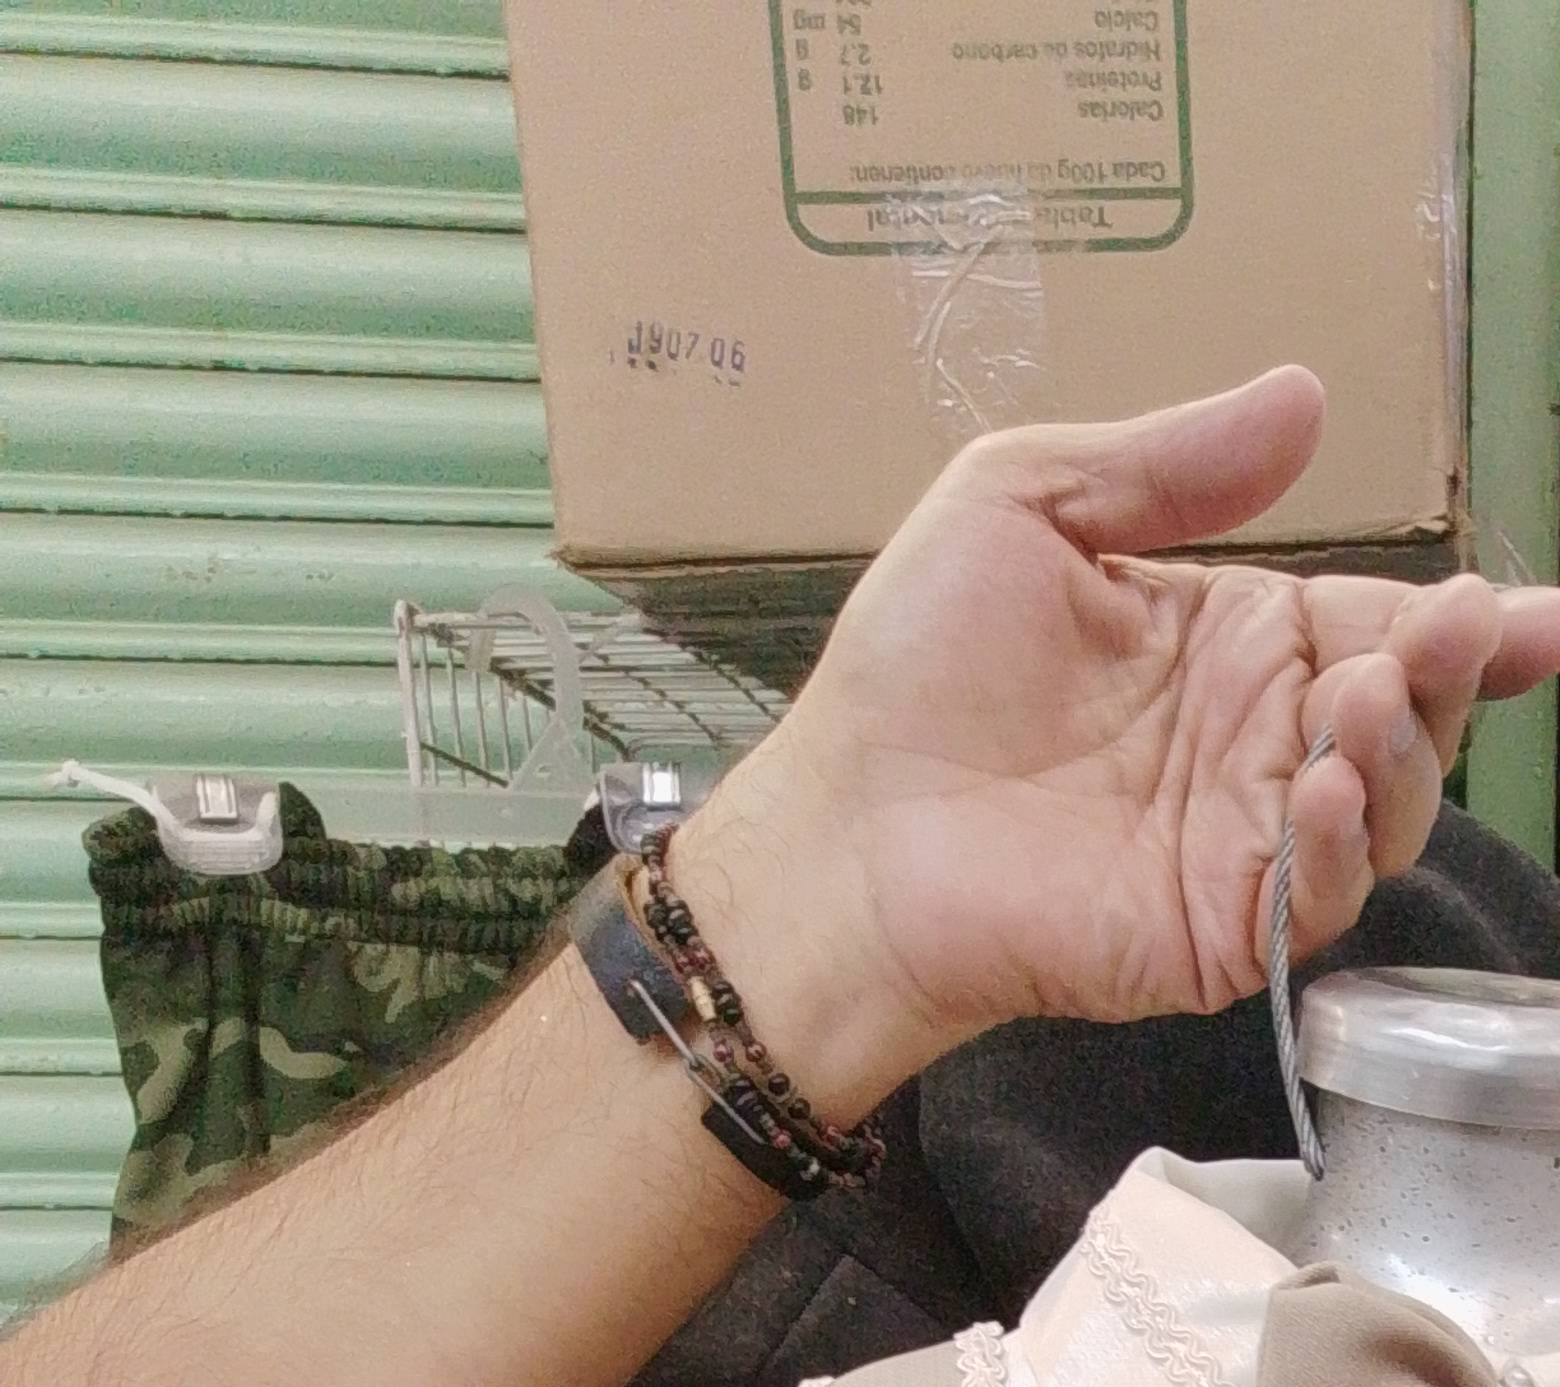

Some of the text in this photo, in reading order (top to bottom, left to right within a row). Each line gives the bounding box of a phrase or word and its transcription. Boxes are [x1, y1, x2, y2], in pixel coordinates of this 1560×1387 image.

[1094, 10, 1160, 30] Calcio
[1056, 159, 1106, 184] 100g
[1112, 160, 1166, 183] Cada
